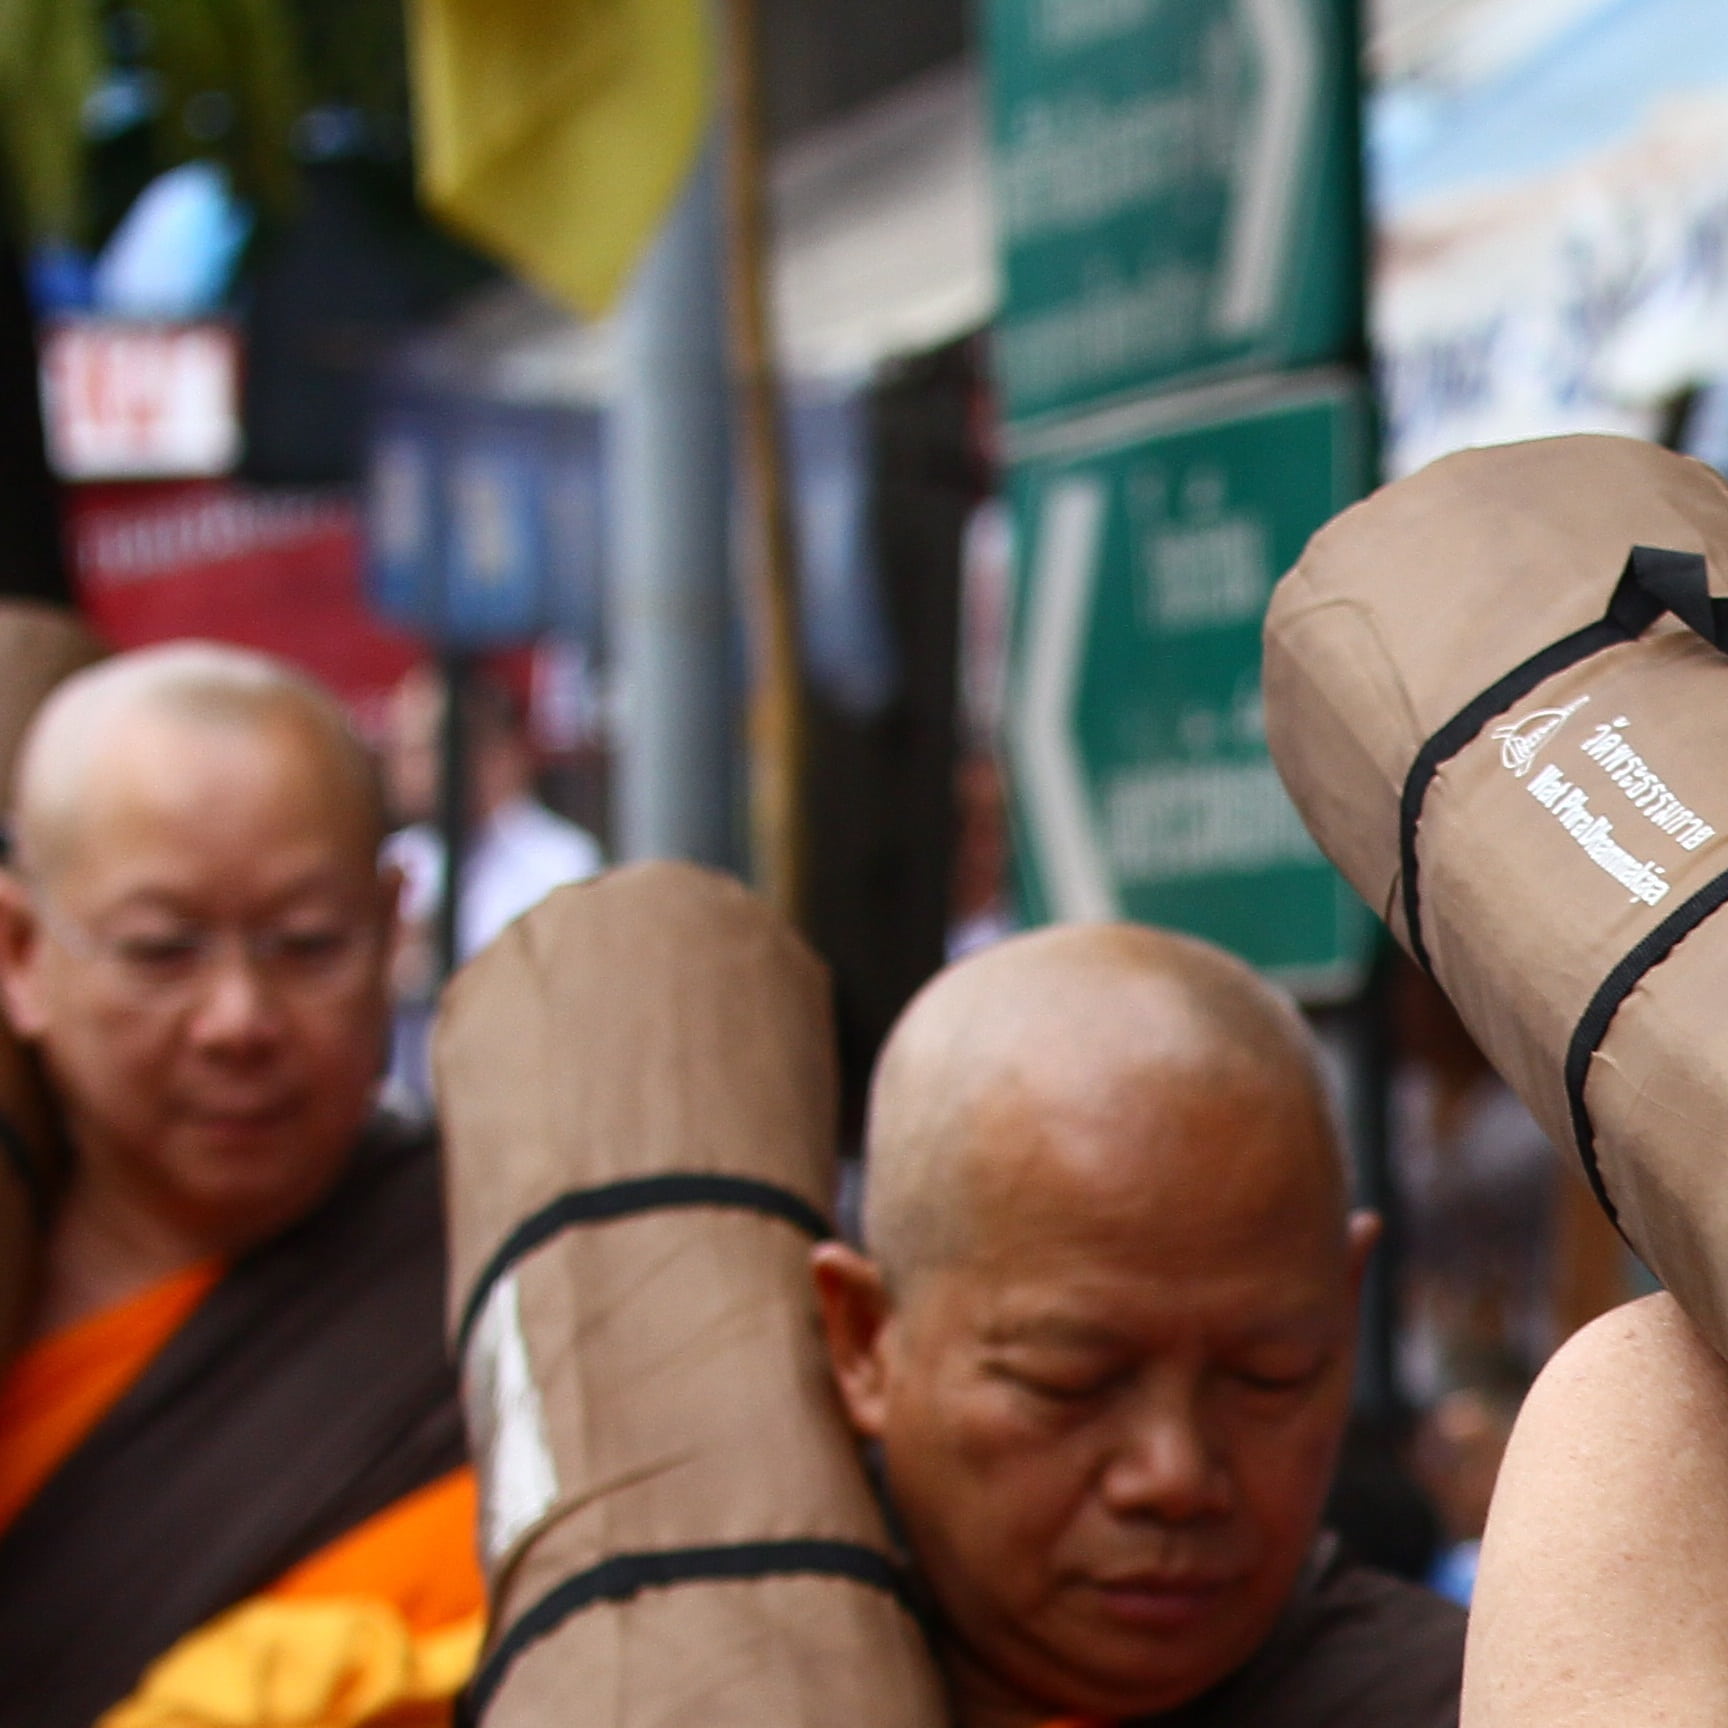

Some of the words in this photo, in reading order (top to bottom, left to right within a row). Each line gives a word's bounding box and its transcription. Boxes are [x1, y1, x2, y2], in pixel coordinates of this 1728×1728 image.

[1526, 763, 1575, 809] Wat
[1579, 715, 1717, 851] วัดพระธรรมกาย
